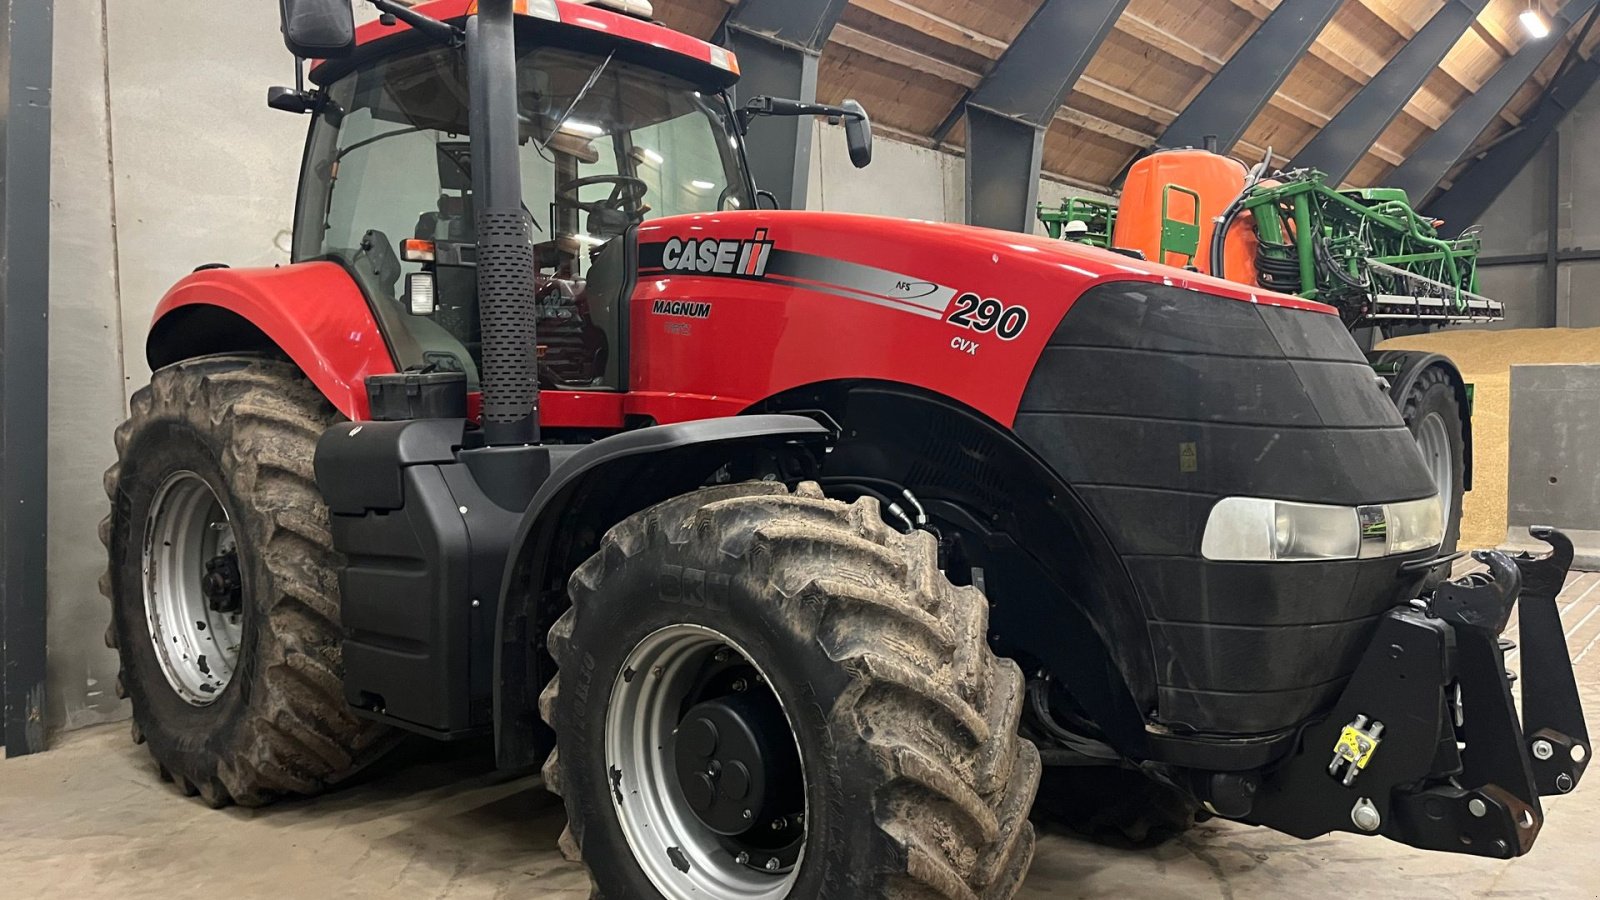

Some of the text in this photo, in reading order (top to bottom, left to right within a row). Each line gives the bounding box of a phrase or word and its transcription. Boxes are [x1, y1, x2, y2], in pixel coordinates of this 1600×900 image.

[662, 238, 739, 274] CASE
[653, 299, 711, 319] MAGNUM
[946, 292, 1029, 341] 290
[950, 336, 980, 355] CVX
